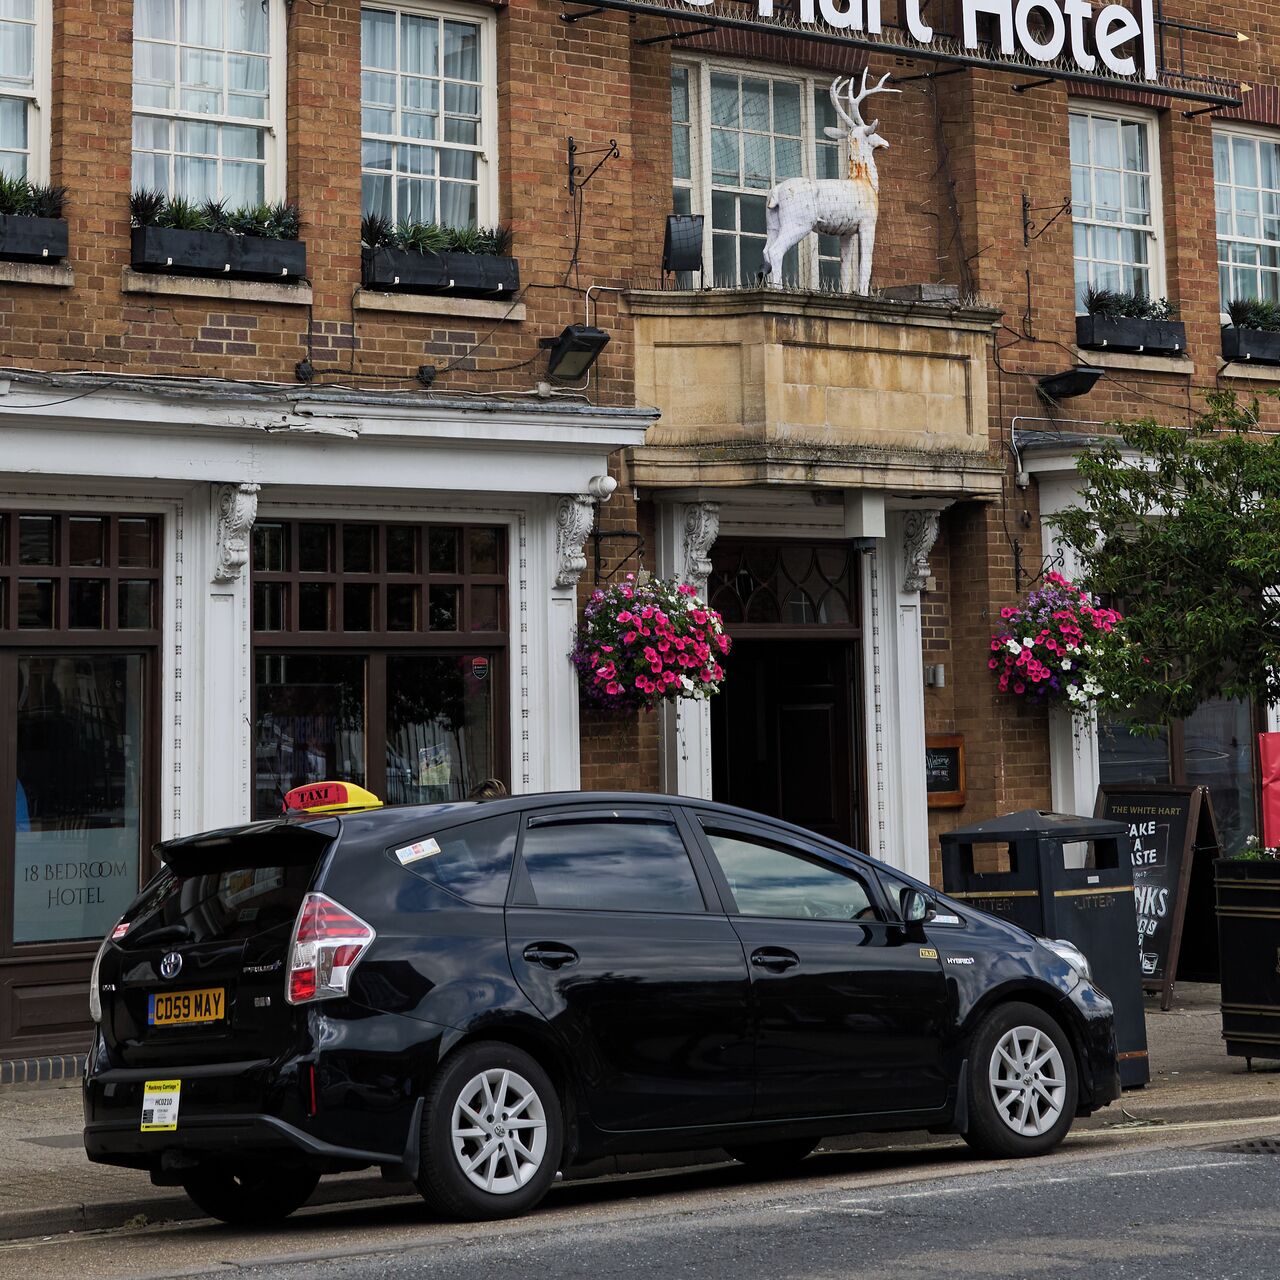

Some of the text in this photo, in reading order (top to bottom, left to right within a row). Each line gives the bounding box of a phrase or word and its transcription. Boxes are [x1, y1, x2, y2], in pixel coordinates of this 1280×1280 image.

[298, 788, 328, 803] TAXI
[1112, 805, 1181, 816] THE WHITE HART
[1133, 841, 1142, 851] A
[24, 861, 128, 882] 18 BEDROOM
[47, 887, 105, 909] HOTEL
[1077, 895, 1113, 910] LITTER
[155, 992, 222, 1021] CD59 MAY
